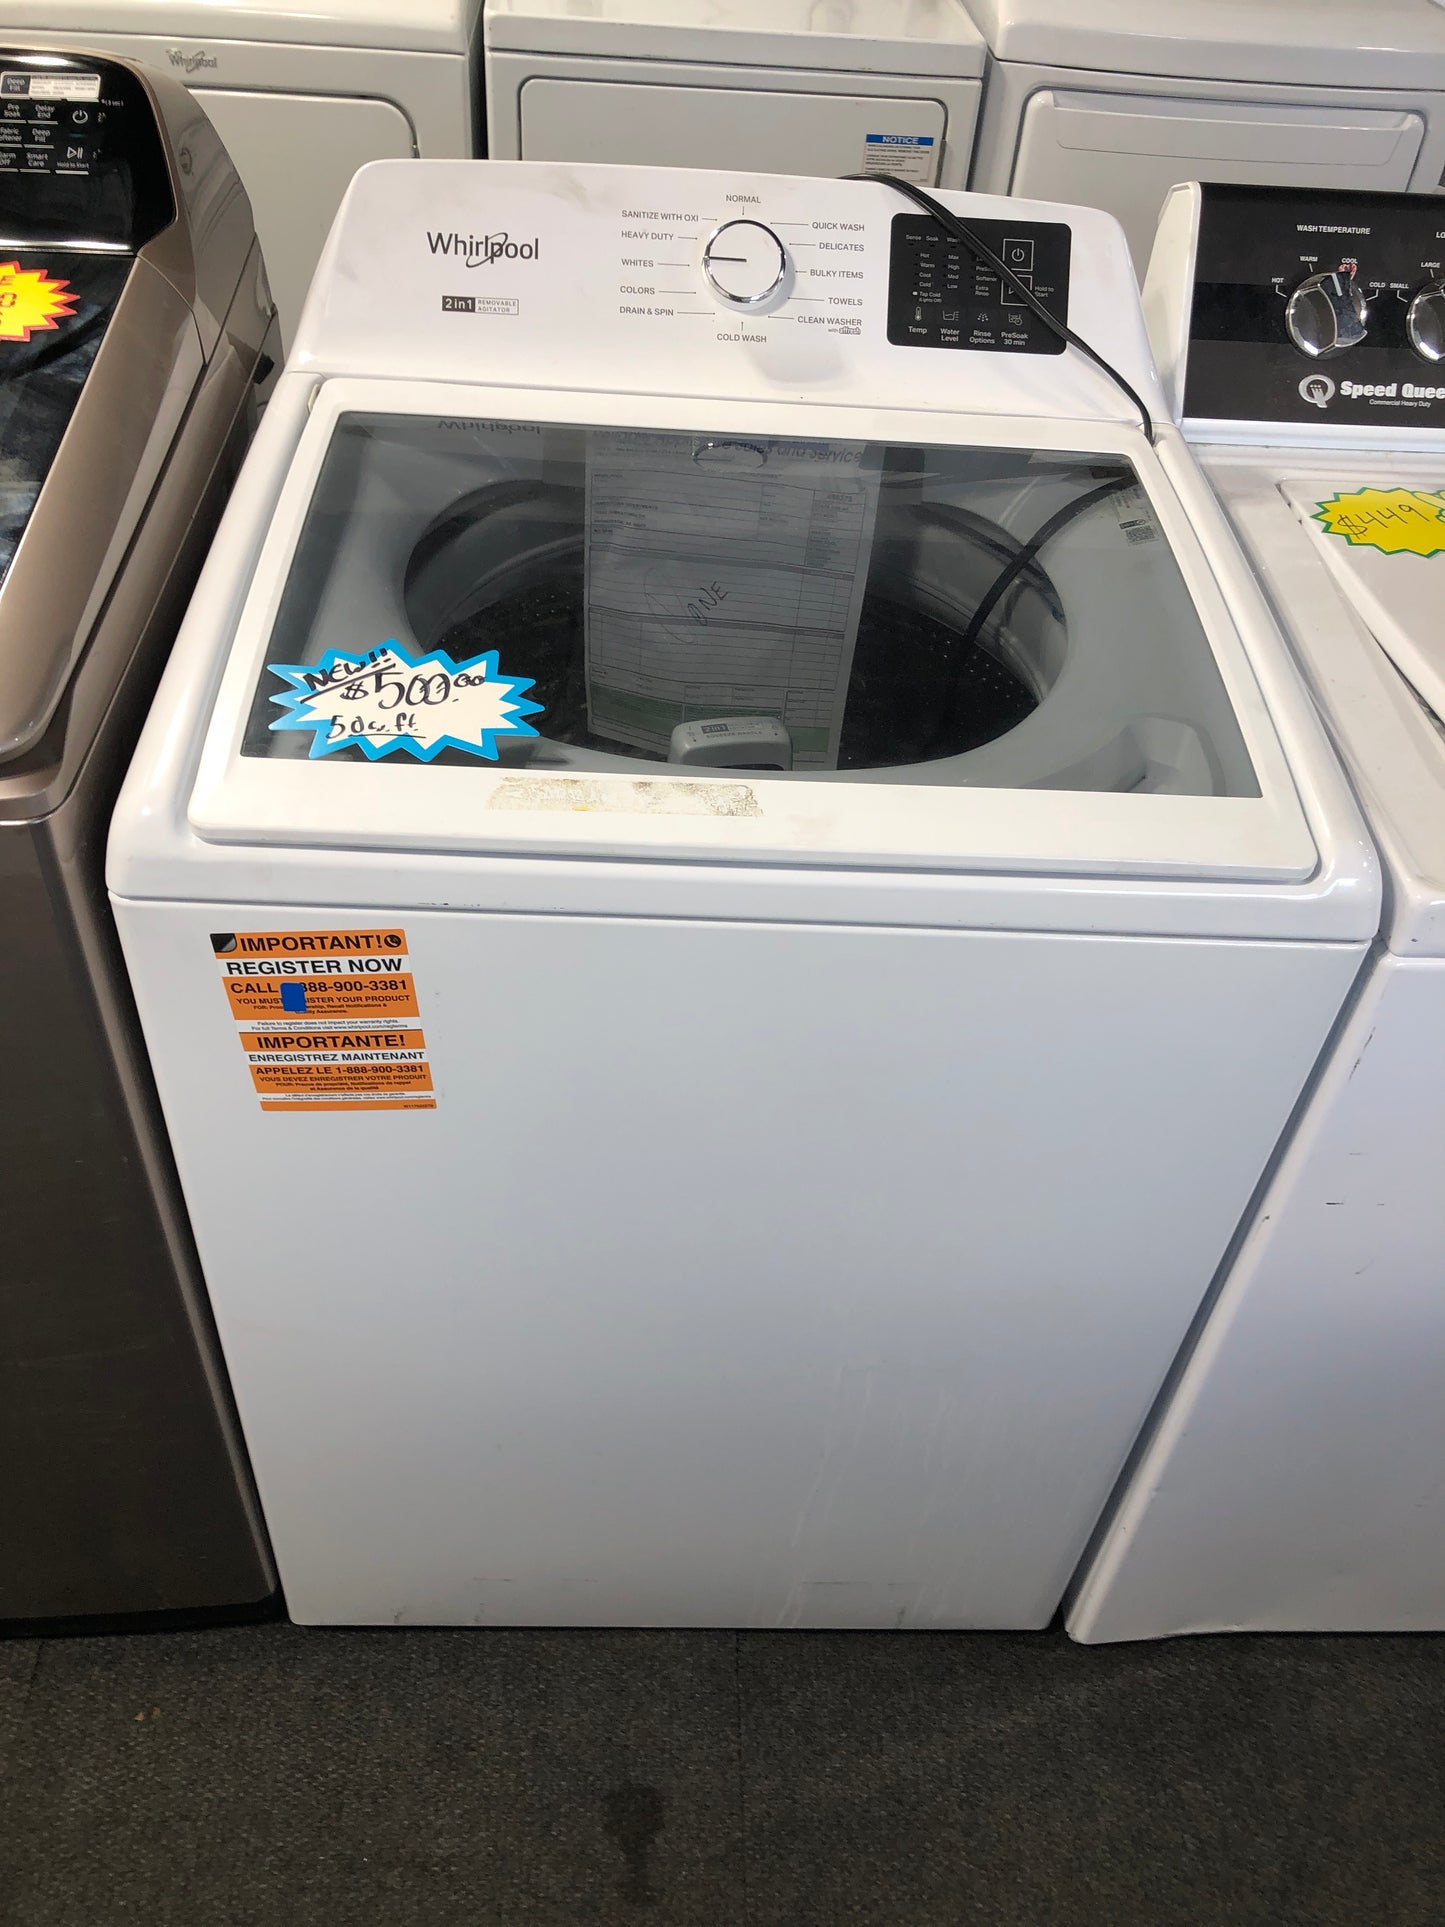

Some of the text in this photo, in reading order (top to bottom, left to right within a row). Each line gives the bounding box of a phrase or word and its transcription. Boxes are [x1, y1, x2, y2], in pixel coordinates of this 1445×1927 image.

[166, 49, 217, 73] Whirlpool
[882, 136, 919, 144] NOTICE
[725, 195, 761, 204] NORMAL
[621, 210, 699, 222] SANITIZE WITH OXI
[812, 221, 865, 231] QUICK WASH
[1296, 224, 1371, 235] WASH TEMPERATURE
[621, 231, 674, 241] HEAVY DUTY
[427, 232, 539, 268] Whirlpool
[819, 242, 865, 252] DELICATES
[621, 258, 654, 267] WHITES
[810, 269, 864, 279] BULKY ITEMS
[620, 286, 655, 295] COLORS
[828, 297, 863, 306] TOWELS
[619, 306, 674, 316] DRAIN & SPIN
[797, 315, 862, 326] CLEAN WASHER
[908, 326, 927, 334] Temp
[716, 333, 767, 343] COLD WASH
[969, 336, 995, 344] Options
[1340, 380, 1397, 399] Speed
[1337, 504, 1430, 540] $449
[240, 935, 382, 952] IMPORTANT!
[226, 958, 402, 975] REGISTER NOW
[231, 982, 279, 993] CALL
[336, 995, 363, 1003] YOUR
[365, 994, 410, 1002] PRODUCT
[256, 1034, 405, 1049] IMPORTANTE!
[248, 1051, 424, 1062] ENREGISTREZ MAINTENANT
[256, 1067, 313, 1075] APPELEZ
[336, 1065, 423, 1074] 1-888-900-3381
